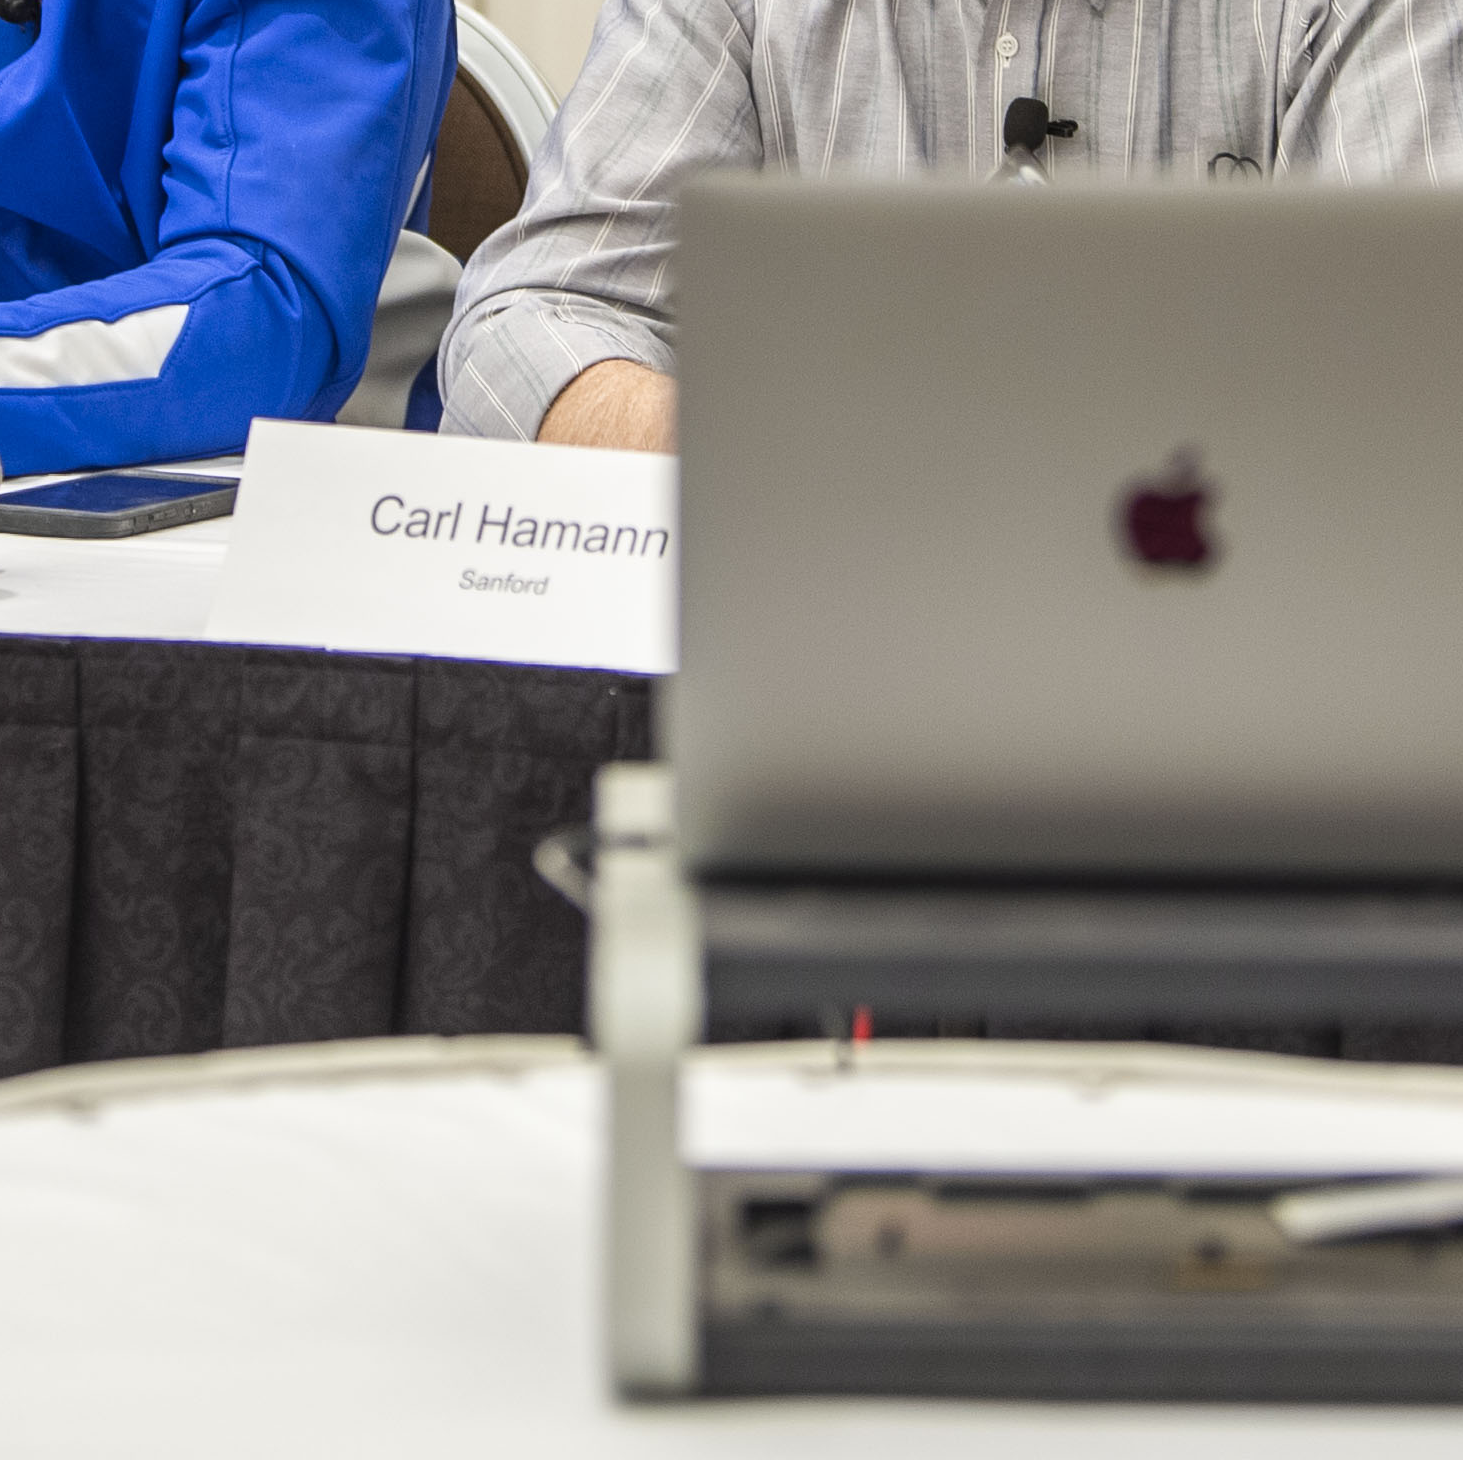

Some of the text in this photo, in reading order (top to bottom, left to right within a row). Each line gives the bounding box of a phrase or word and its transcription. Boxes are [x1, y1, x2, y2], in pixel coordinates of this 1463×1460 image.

[370, 495, 670, 559] Carl Hamann
[458, 569, 550, 597] Sanford
